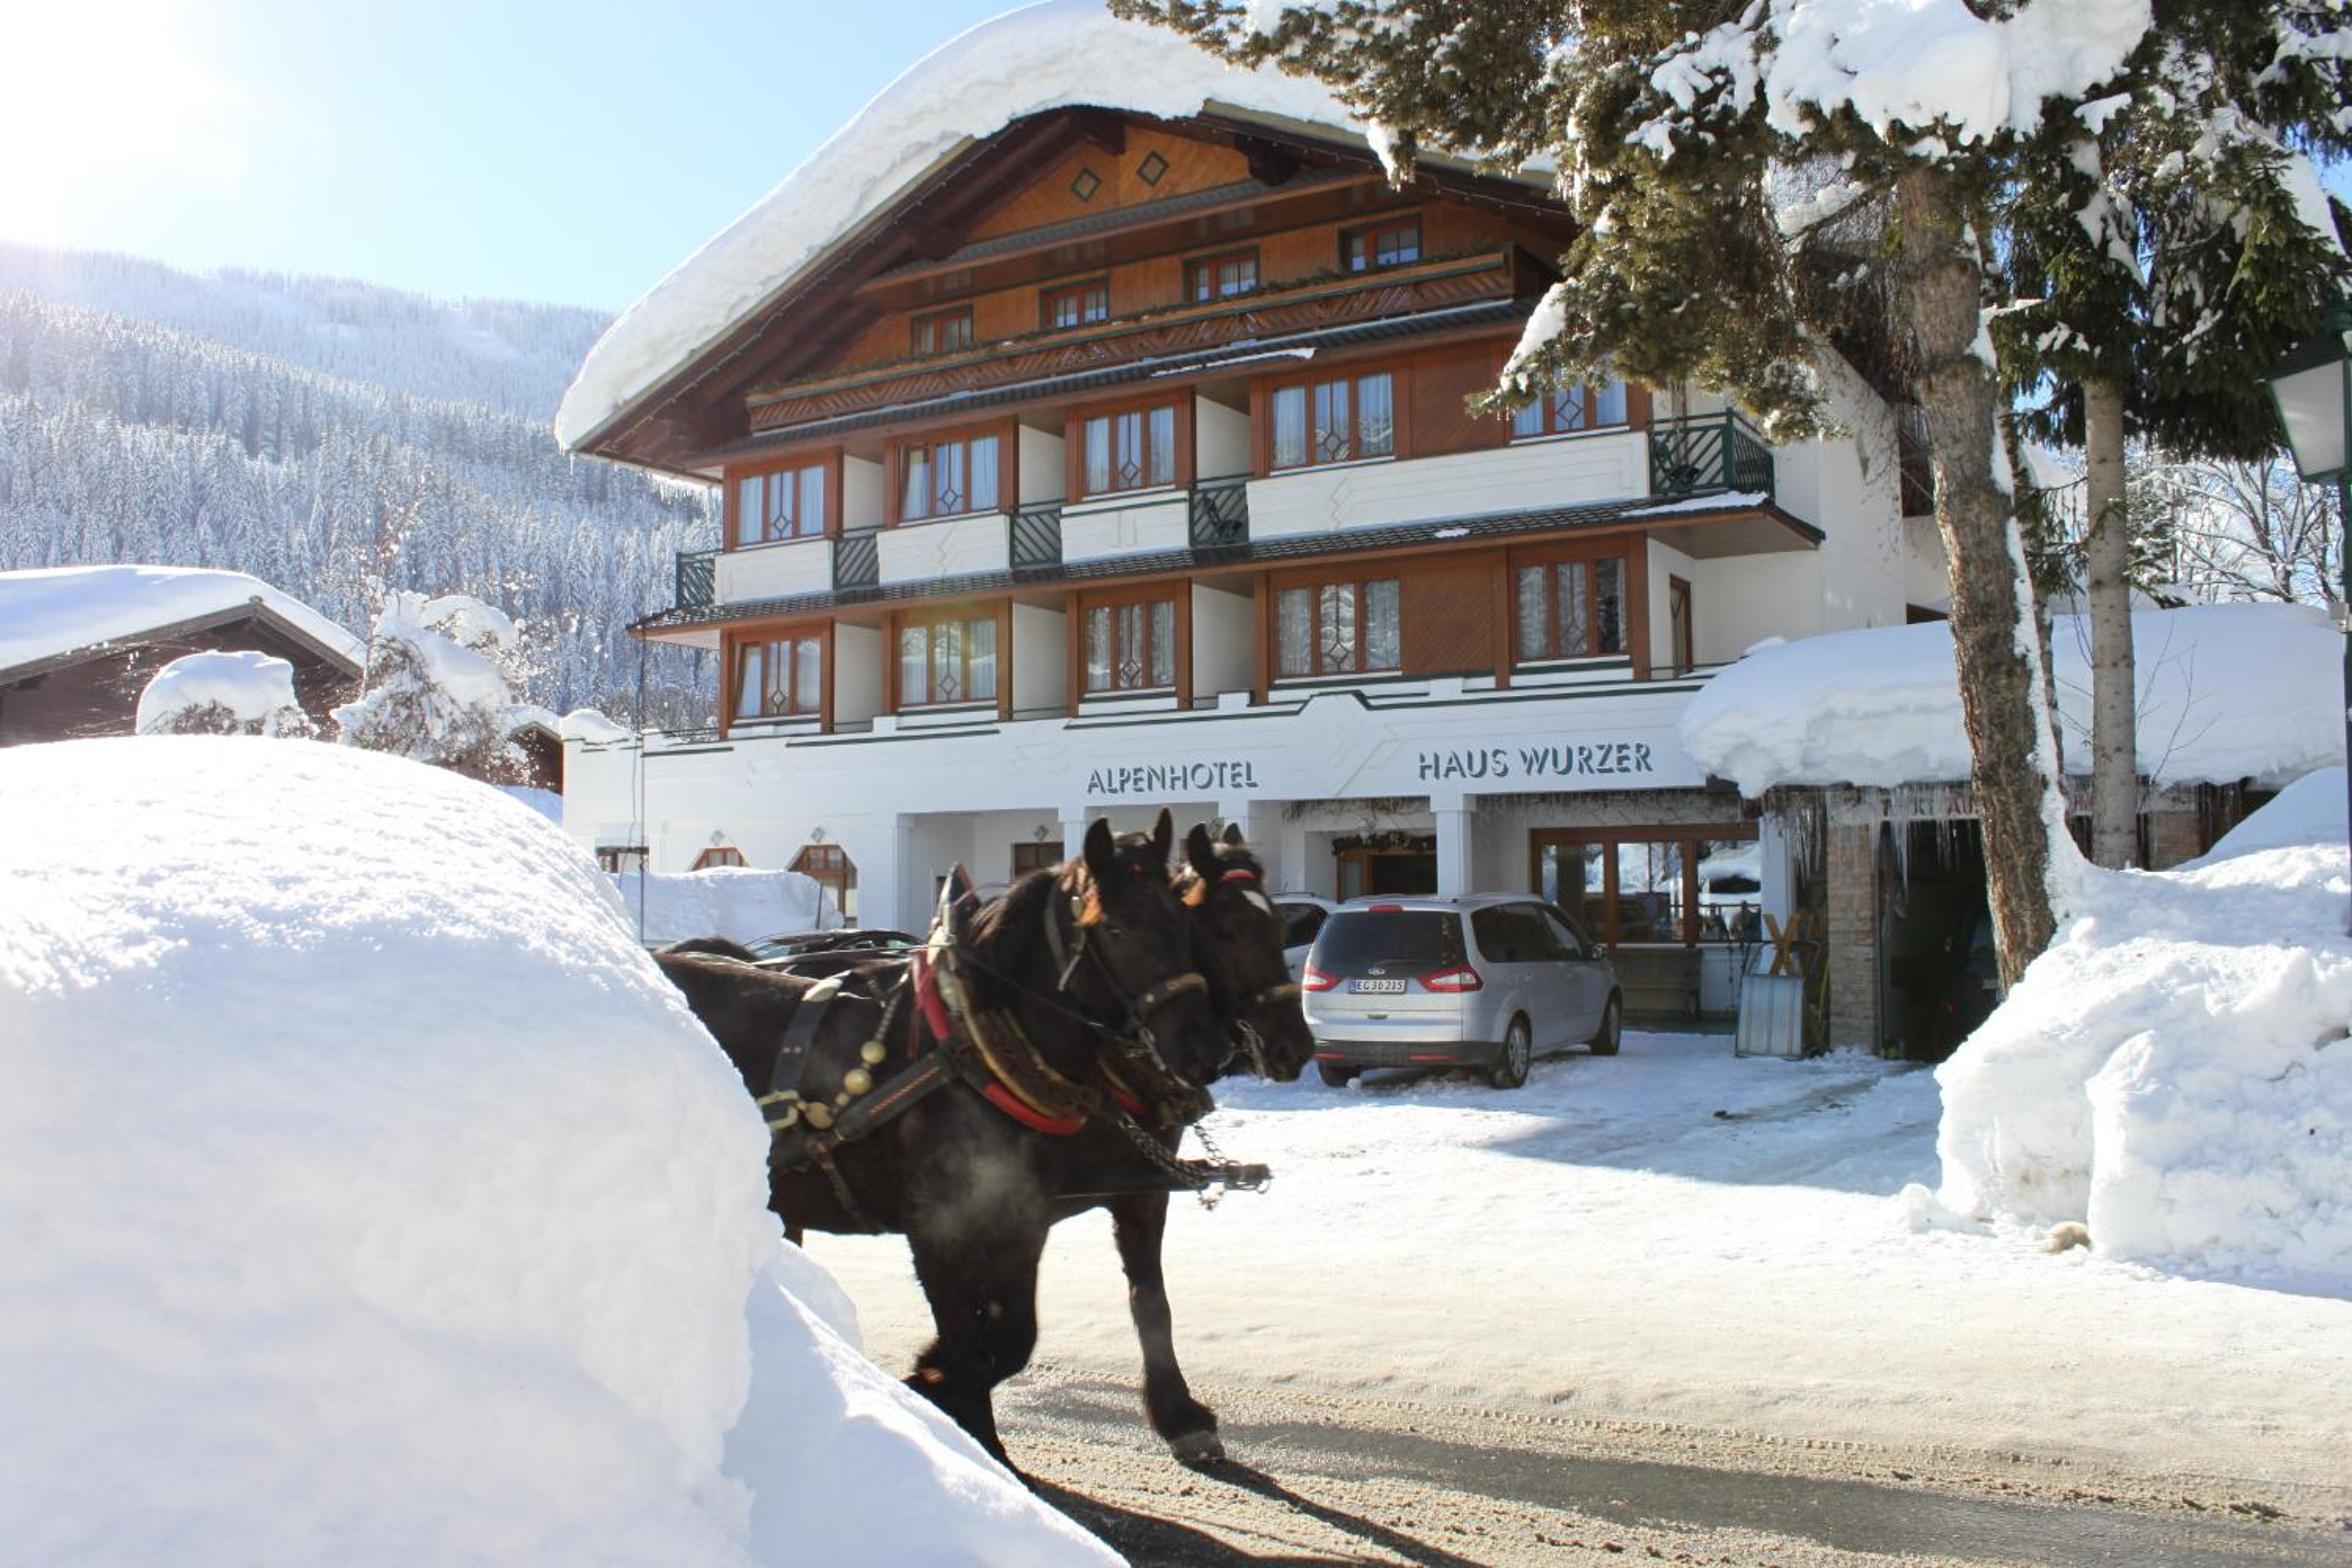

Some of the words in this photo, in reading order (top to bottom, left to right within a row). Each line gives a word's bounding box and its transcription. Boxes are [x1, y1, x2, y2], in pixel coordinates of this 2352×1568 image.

[1087, 761, 1259, 795] ALPENHOTEL
[1419, 748, 1510, 781] HAUS
[1519, 743, 1653, 776] WURZER
